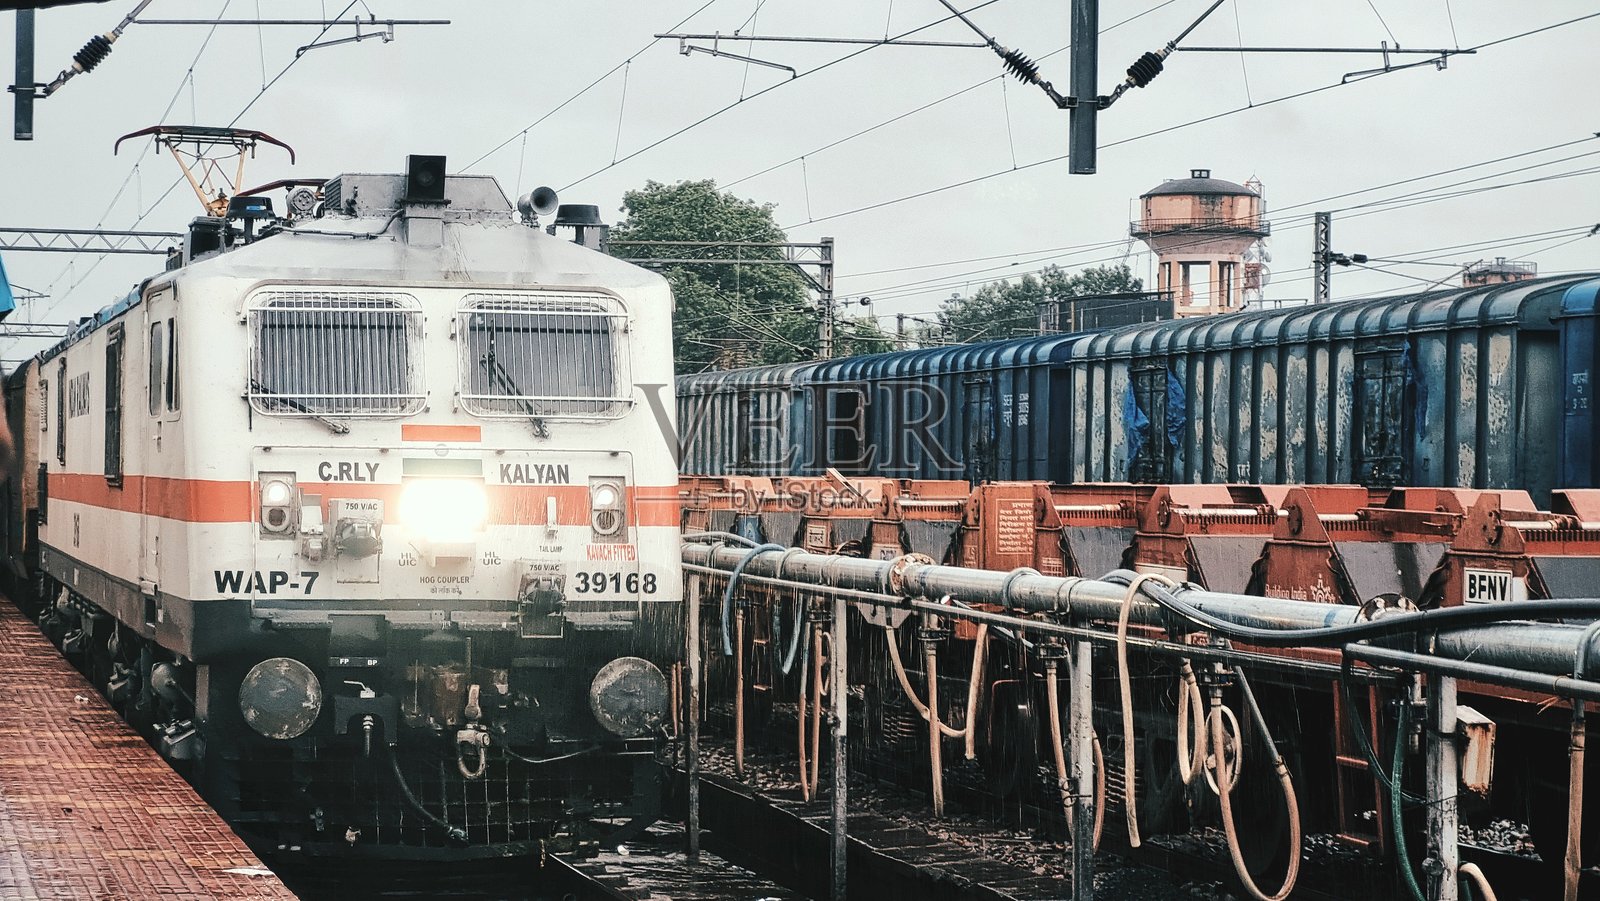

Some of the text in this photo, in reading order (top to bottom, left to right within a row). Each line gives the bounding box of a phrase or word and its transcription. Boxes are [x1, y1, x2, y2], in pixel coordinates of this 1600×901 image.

[318, 461, 380, 482] C.RLY
[499, 463, 570, 484] KALYAN
[345, 502, 359, 511] 750
[482, 558, 502, 566] UIC
[586, 544, 636, 561] KAVACH FITTED
[398, 559, 417, 567] UIC
[214, 570, 320, 595] WAP-7
[574, 572, 657, 595] 39168
[1468, 573, 1508, 601] BFNV
[1291, 586, 1307, 600] India
